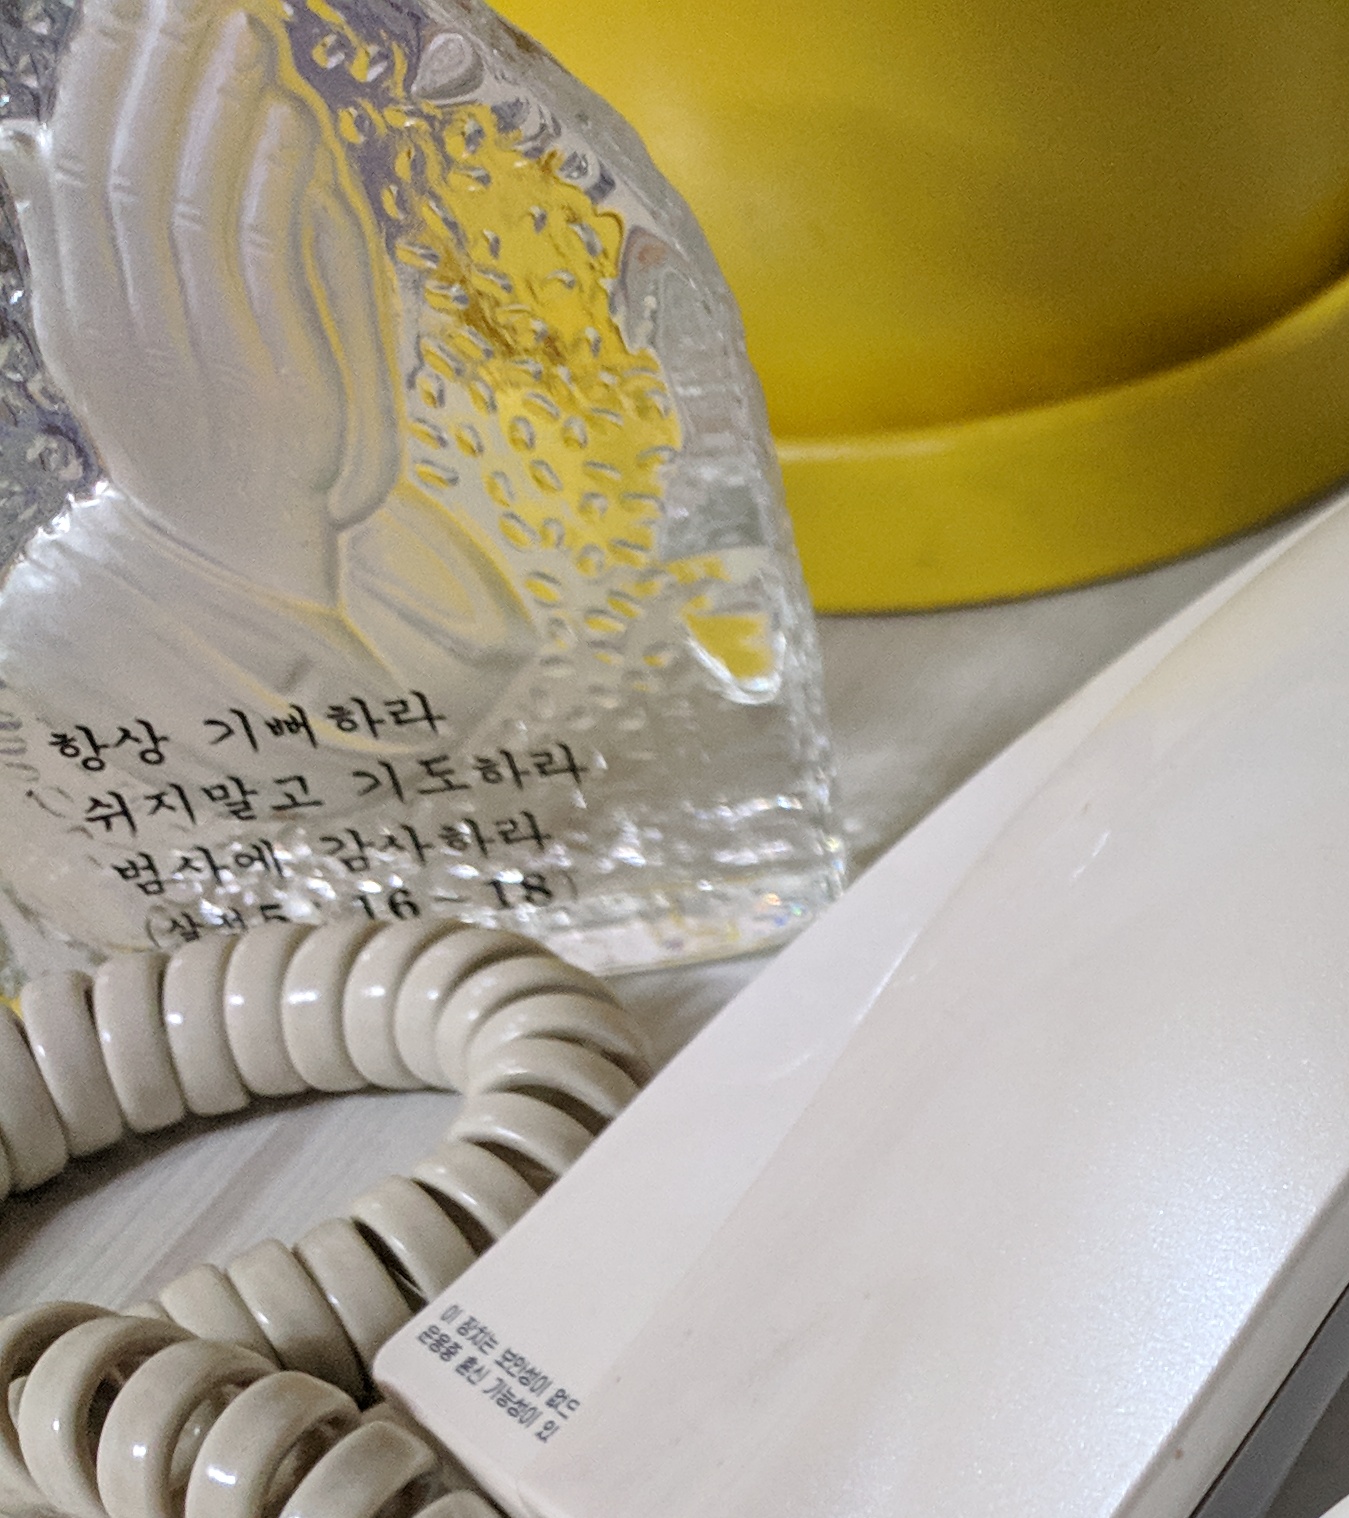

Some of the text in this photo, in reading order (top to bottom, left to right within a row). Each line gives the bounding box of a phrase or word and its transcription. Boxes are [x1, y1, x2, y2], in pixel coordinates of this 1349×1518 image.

[48, 690, 448, 772] 항상 기뻐하라
[84, 741, 590, 837] 쉬지말고 기도하라
[111, 810, 551, 897] 범사에 감사하라
